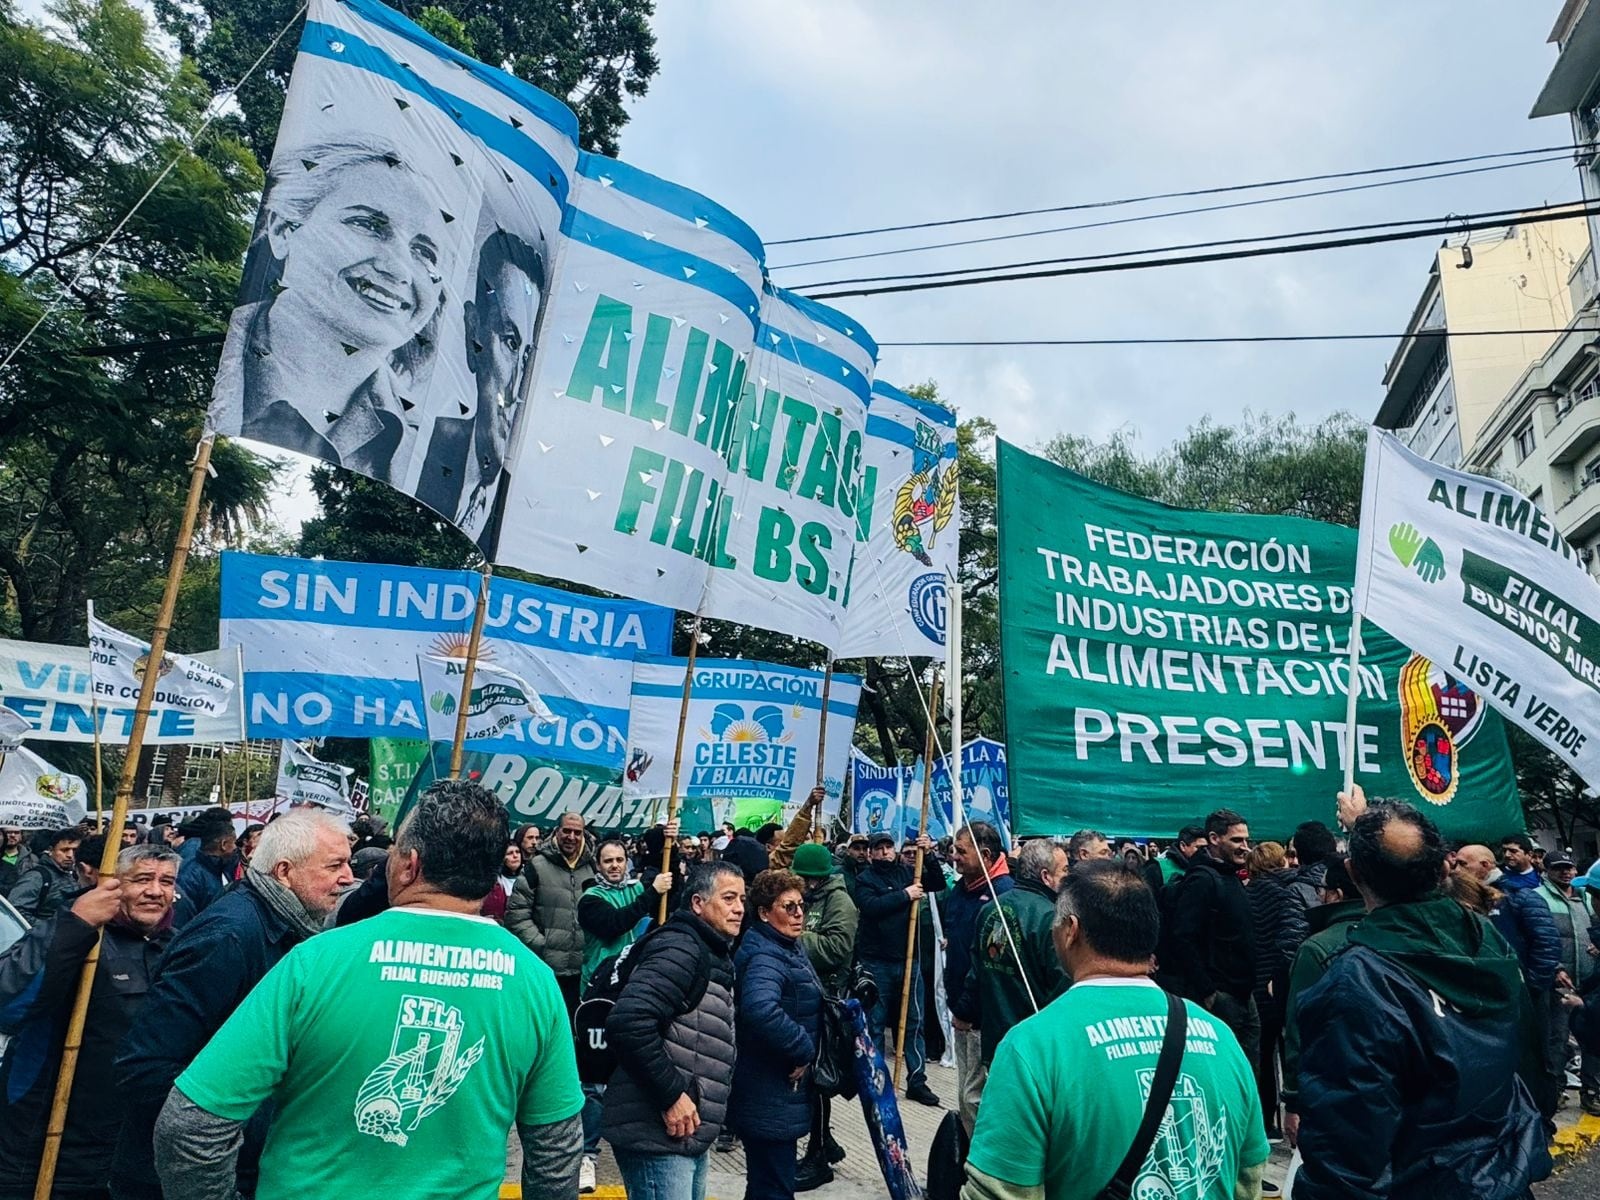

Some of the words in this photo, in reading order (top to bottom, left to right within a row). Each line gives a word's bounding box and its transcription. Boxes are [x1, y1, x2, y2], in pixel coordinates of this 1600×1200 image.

[1085, 523, 1311, 574] FEDERACIÓN
[1037, 547, 1322, 612] TRABAJADORES
[1326, 586, 1355, 614] D
[258, 570, 358, 614] SIN
[378, 580, 647, 650] INDUSTRIA
[1055, 592, 1269, 649] INDUSTRIAS
[1276, 621, 1322, 652] DE
[1469, 584, 1561, 654] BUENOS
[1564, 646, 1600, 690] AIRE
[1503, 576, 1582, 643] FILIAL
[1046, 634, 1388, 701] ALIMENTACIÓN
[251, 691, 333, 725] NO
[353, 695, 424, 730] HA
[494, 713, 627, 753] ACIÓN
[1453, 645, 1521, 708] LISTA
[1523, 694, 1587, 758] VERDE
[465, 726, 499, 740] LISTA
[695, 742, 797, 768] CELESTE
[969, 745, 990, 763] LA
[1074, 707, 1381, 773] PRESENTE
[696, 767, 708, 785] Y
[711, 766, 791, 789] BLANCA
[701, 788, 776, 799] ALIMENTACIÓN
[369, 940, 515, 976] ALIMENTACIÓN
[380, 966, 417, 983] FILIAL
[419, 970, 469, 988] BUENOS
[470, 975, 503, 990] AIRES
[1105, 1041, 1138, 1060] FILIAL
[1187, 1042, 1216, 1056] AIRES
